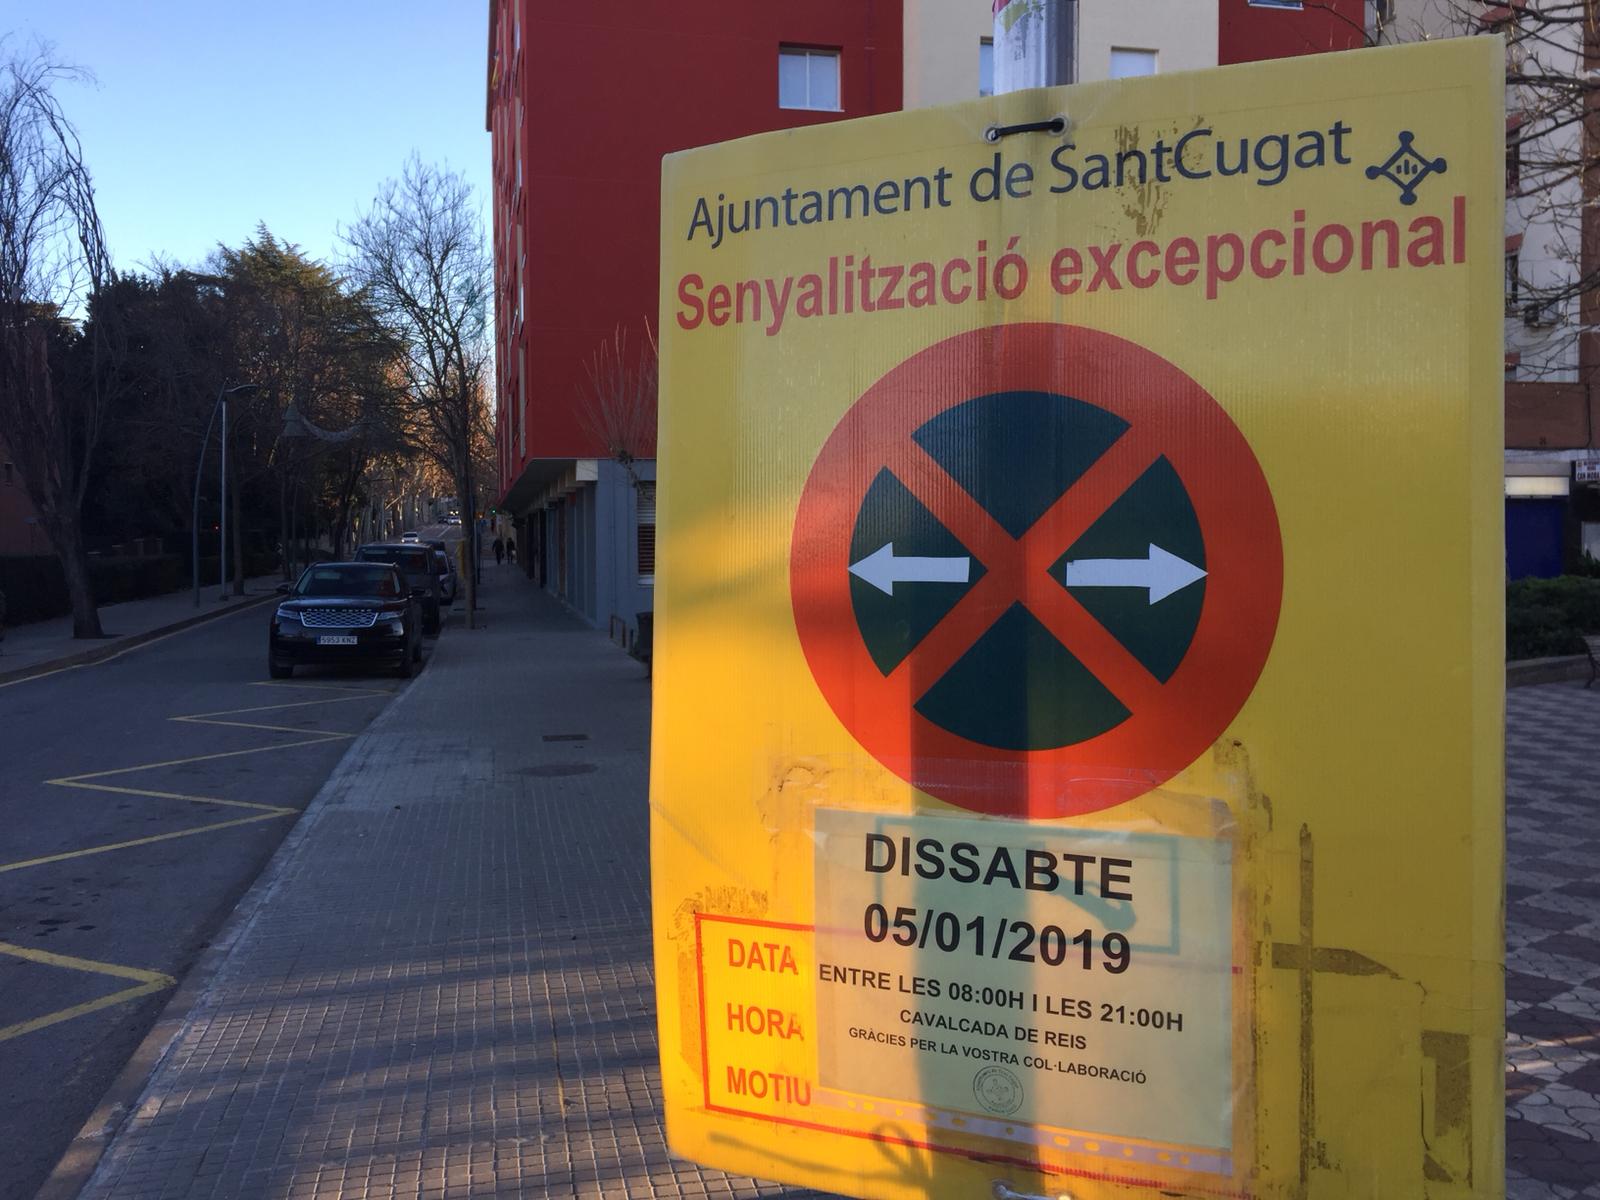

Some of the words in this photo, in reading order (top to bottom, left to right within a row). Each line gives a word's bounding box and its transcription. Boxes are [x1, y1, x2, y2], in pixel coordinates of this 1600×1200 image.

[687, 166, 953, 249] Ajuntament
[969, 152, 1034, 203] de
[676, 236, 1029, 336] Senyalització
[1050, 196, 1467, 300] excepcional
[864, 833, 1132, 901] DISSABTE
[727, 938, 799, 976] DATA
[863, 903, 1131, 974] 05/01/2019
[727, 1003, 805, 1042] HORA
[819, 964, 891, 991] ENTRE
[898, 975, 942, 998] LES
[948, 981, 1024, 1010] 08:00H
[1032, 994, 1037, 1012] I
[1045, 995, 1093, 1019] LES
[1100, 1003, 1184, 1032] 21:00H
[848, 1026, 906, 1047] GRÀCIES
[910, 1037, 936, 1051] PER
[940, 1041, 959, 1056] LA
[962, 1045, 1019, 1067] VOSTRA
[899, 1009, 1008, 1039] CAVALCADA
[1014, 1027, 1039, 1044] DE
[1044, 1030, 1087, 1050] REIS
[727, 1066, 812, 1107] MOTIU
